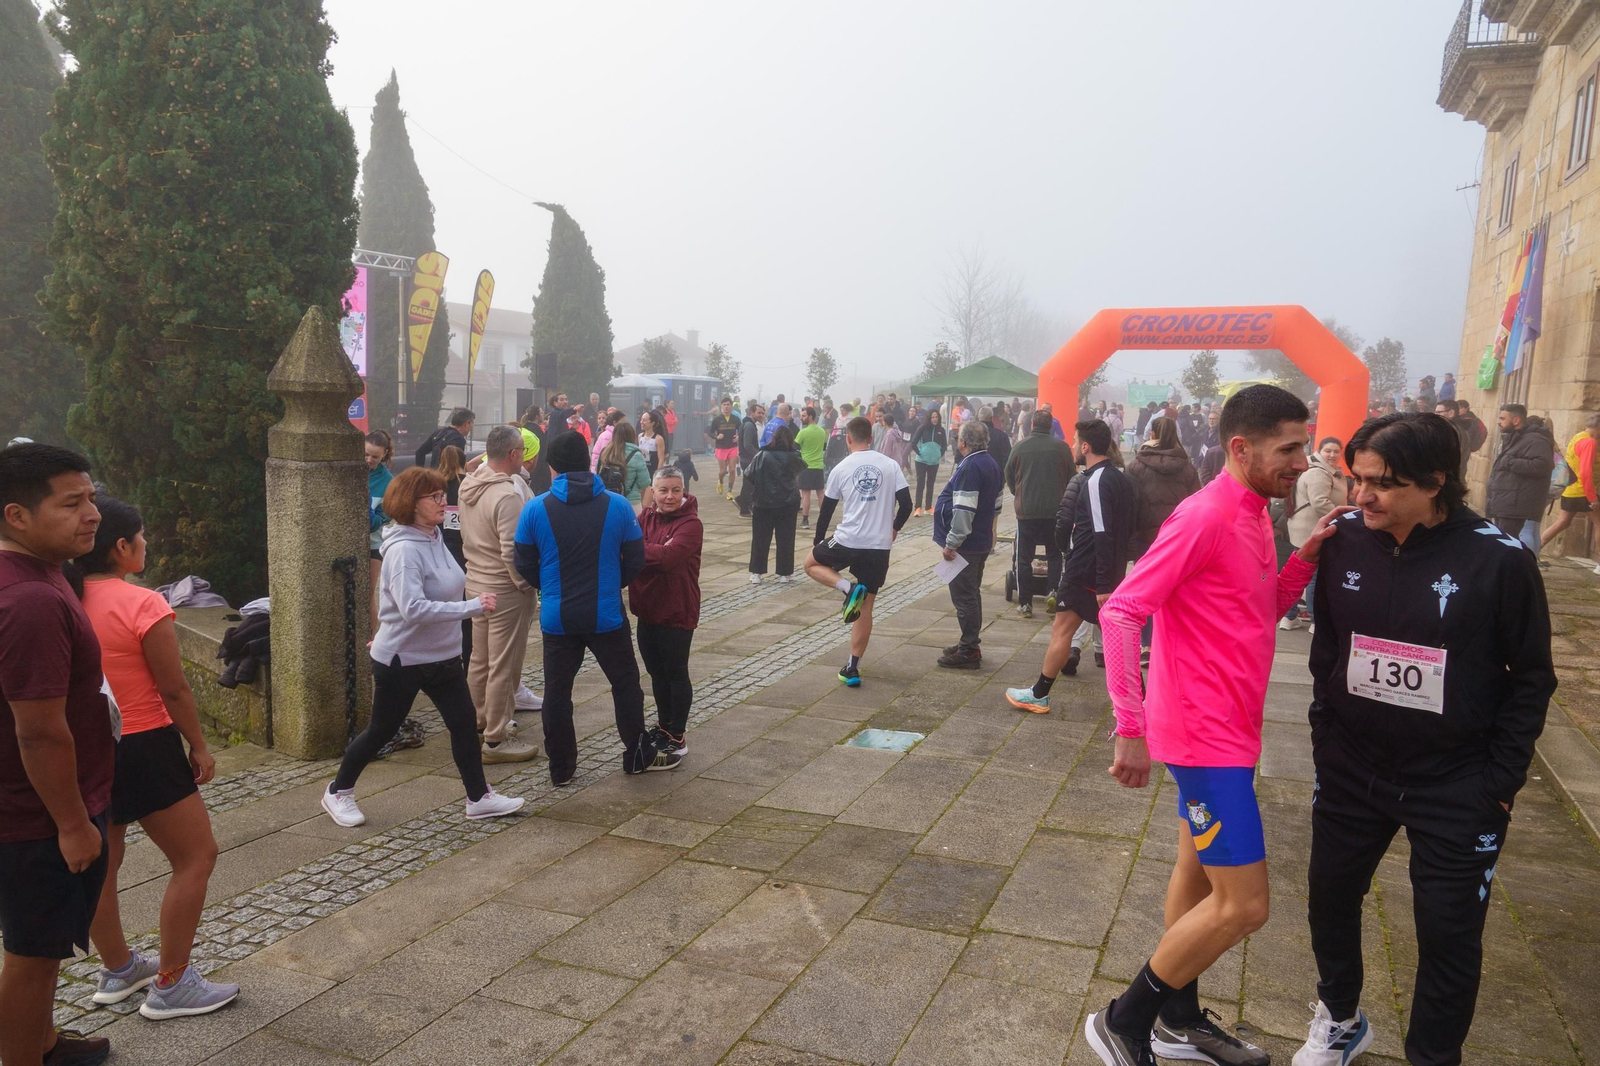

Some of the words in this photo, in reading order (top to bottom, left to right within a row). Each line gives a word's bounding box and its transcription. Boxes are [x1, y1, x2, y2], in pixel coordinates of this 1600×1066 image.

[1122, 313, 1273, 333] CRONOTEC
[1121, 334, 1268, 345] WWW.CRONOTEC.ES
[1358, 643, 1391, 654] CONTRA
[1401, 651, 1438, 662] CANCRO
[1372, 639, 1424, 654] CORREMOS
[1369, 658, 1422, 691] 130
